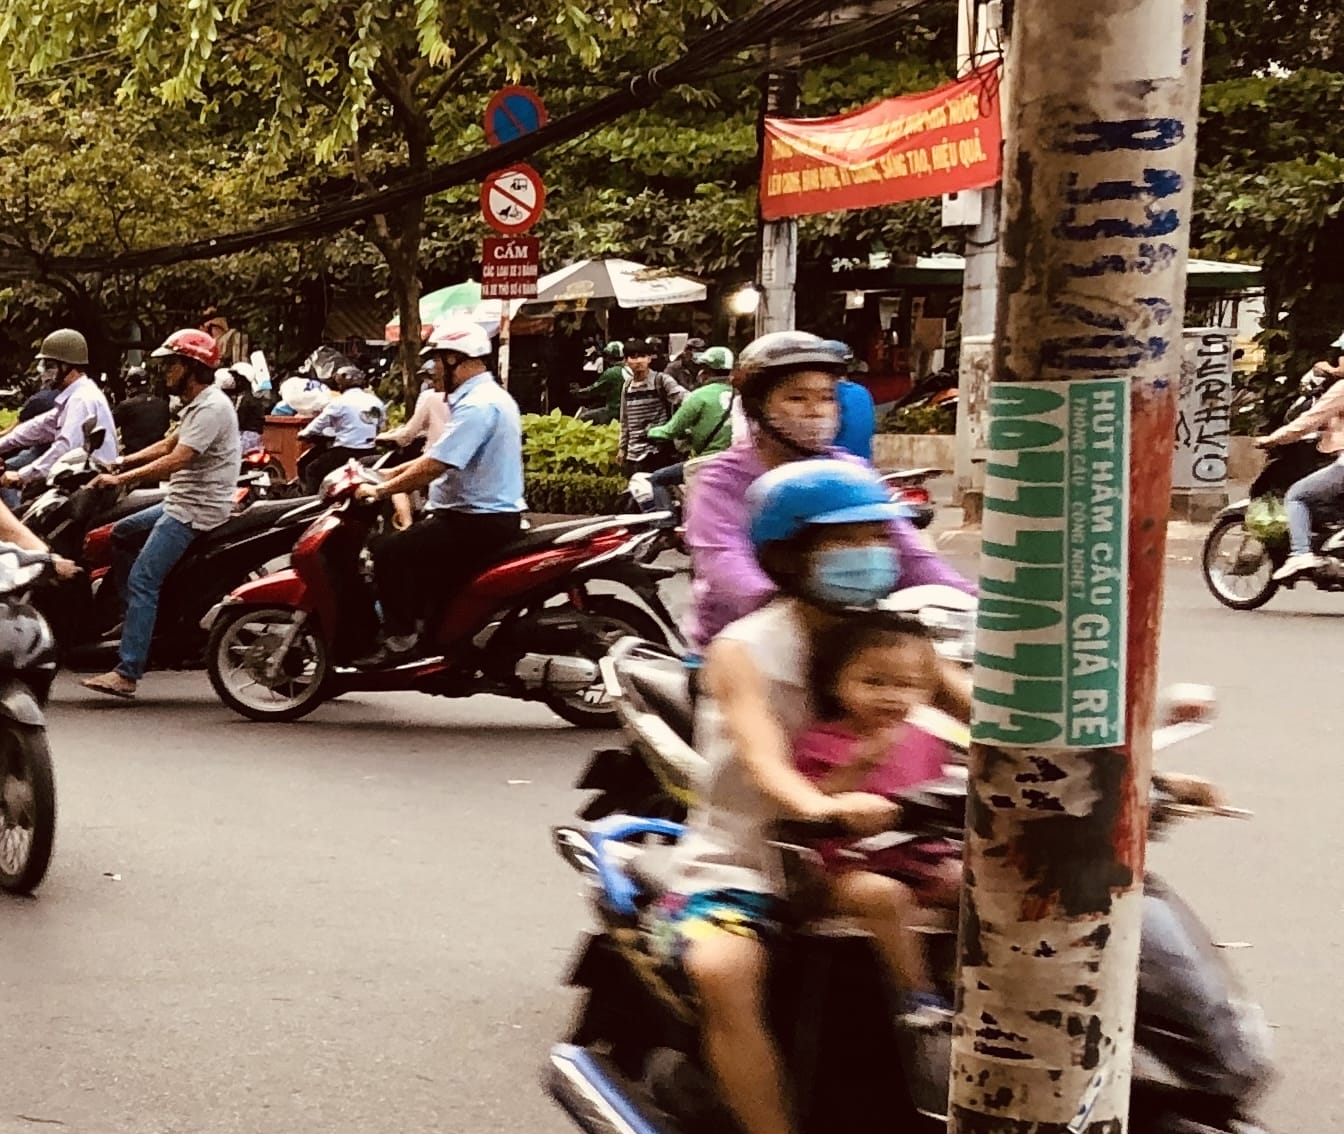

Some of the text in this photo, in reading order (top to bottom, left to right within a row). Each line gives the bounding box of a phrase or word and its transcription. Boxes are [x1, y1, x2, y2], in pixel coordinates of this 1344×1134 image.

[494, 240, 529, 259] CẤM
[1071, 389, 1122, 739] HÚT HẦM CẦU GIÁ RẺ
